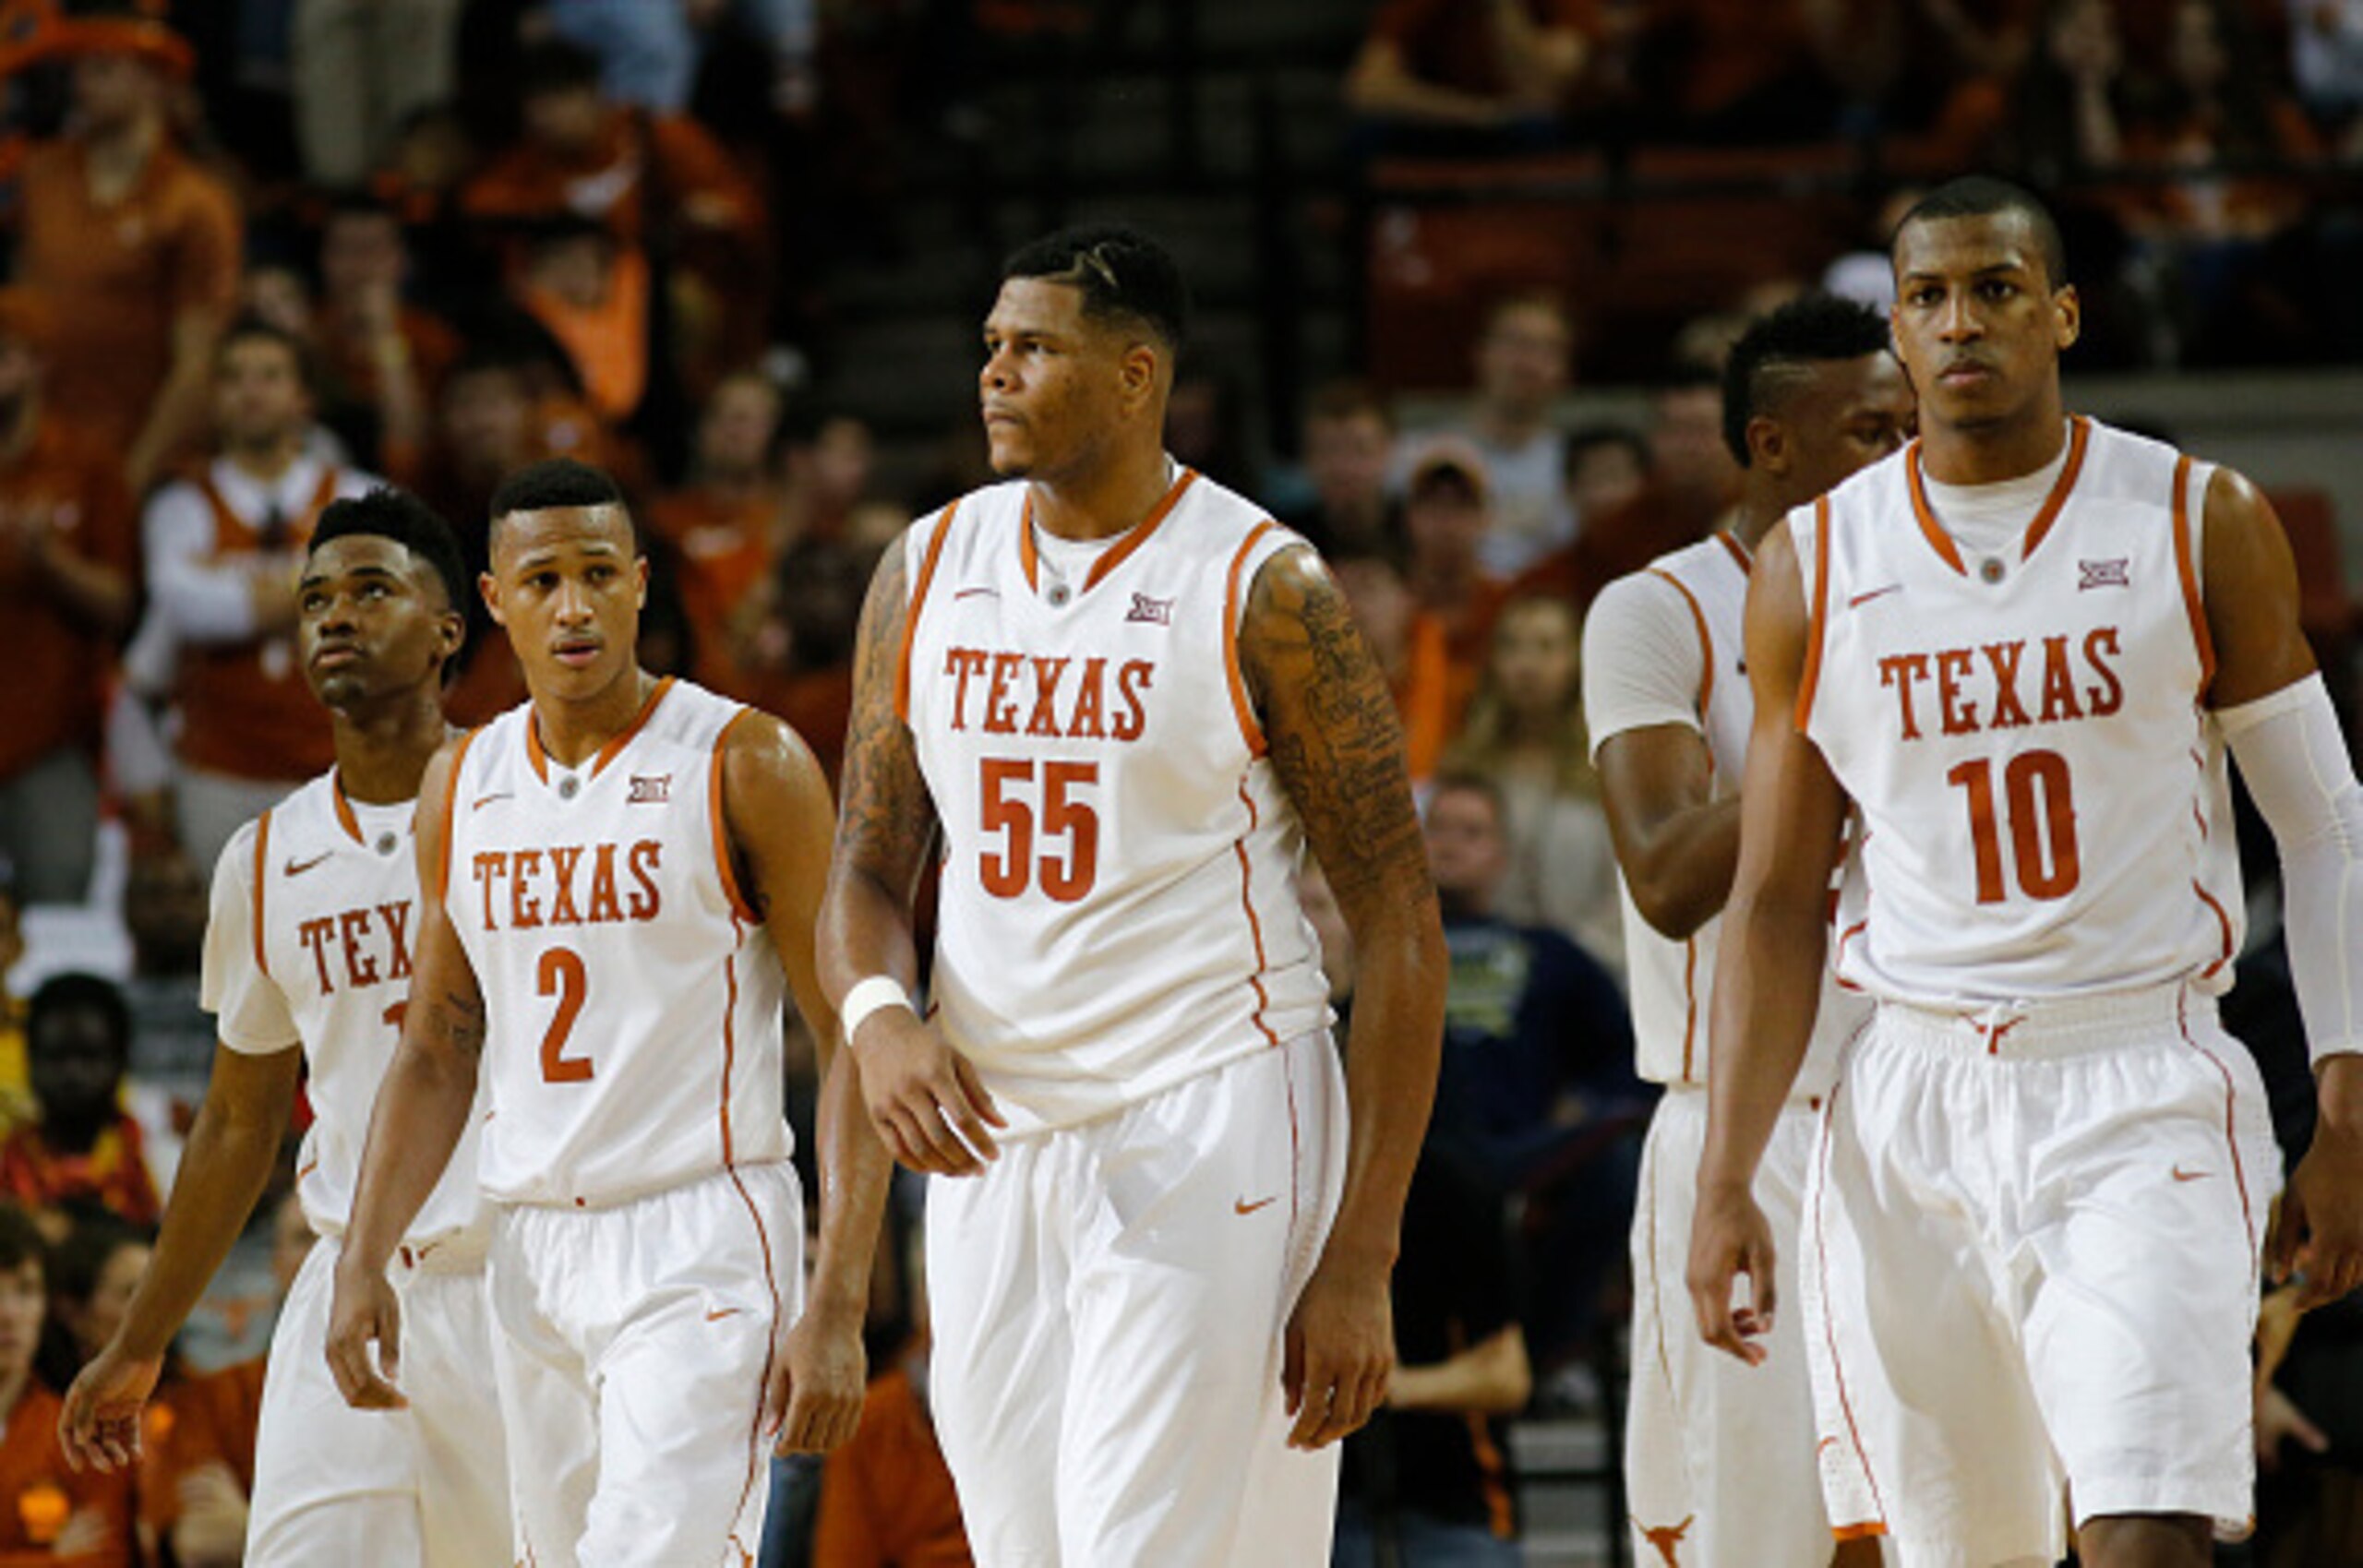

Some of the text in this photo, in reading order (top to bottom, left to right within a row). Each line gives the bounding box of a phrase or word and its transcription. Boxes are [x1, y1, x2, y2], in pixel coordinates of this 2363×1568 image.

[944, 647, 1156, 742] TEXAS
[1879, 627, 2122, 740] TEXAS
[473, 840, 662, 930] TEXAS
[979, 758, 1099, 903] 55
[1948, 749, 2081, 904] 10
[537, 947, 594, 1083] 2
